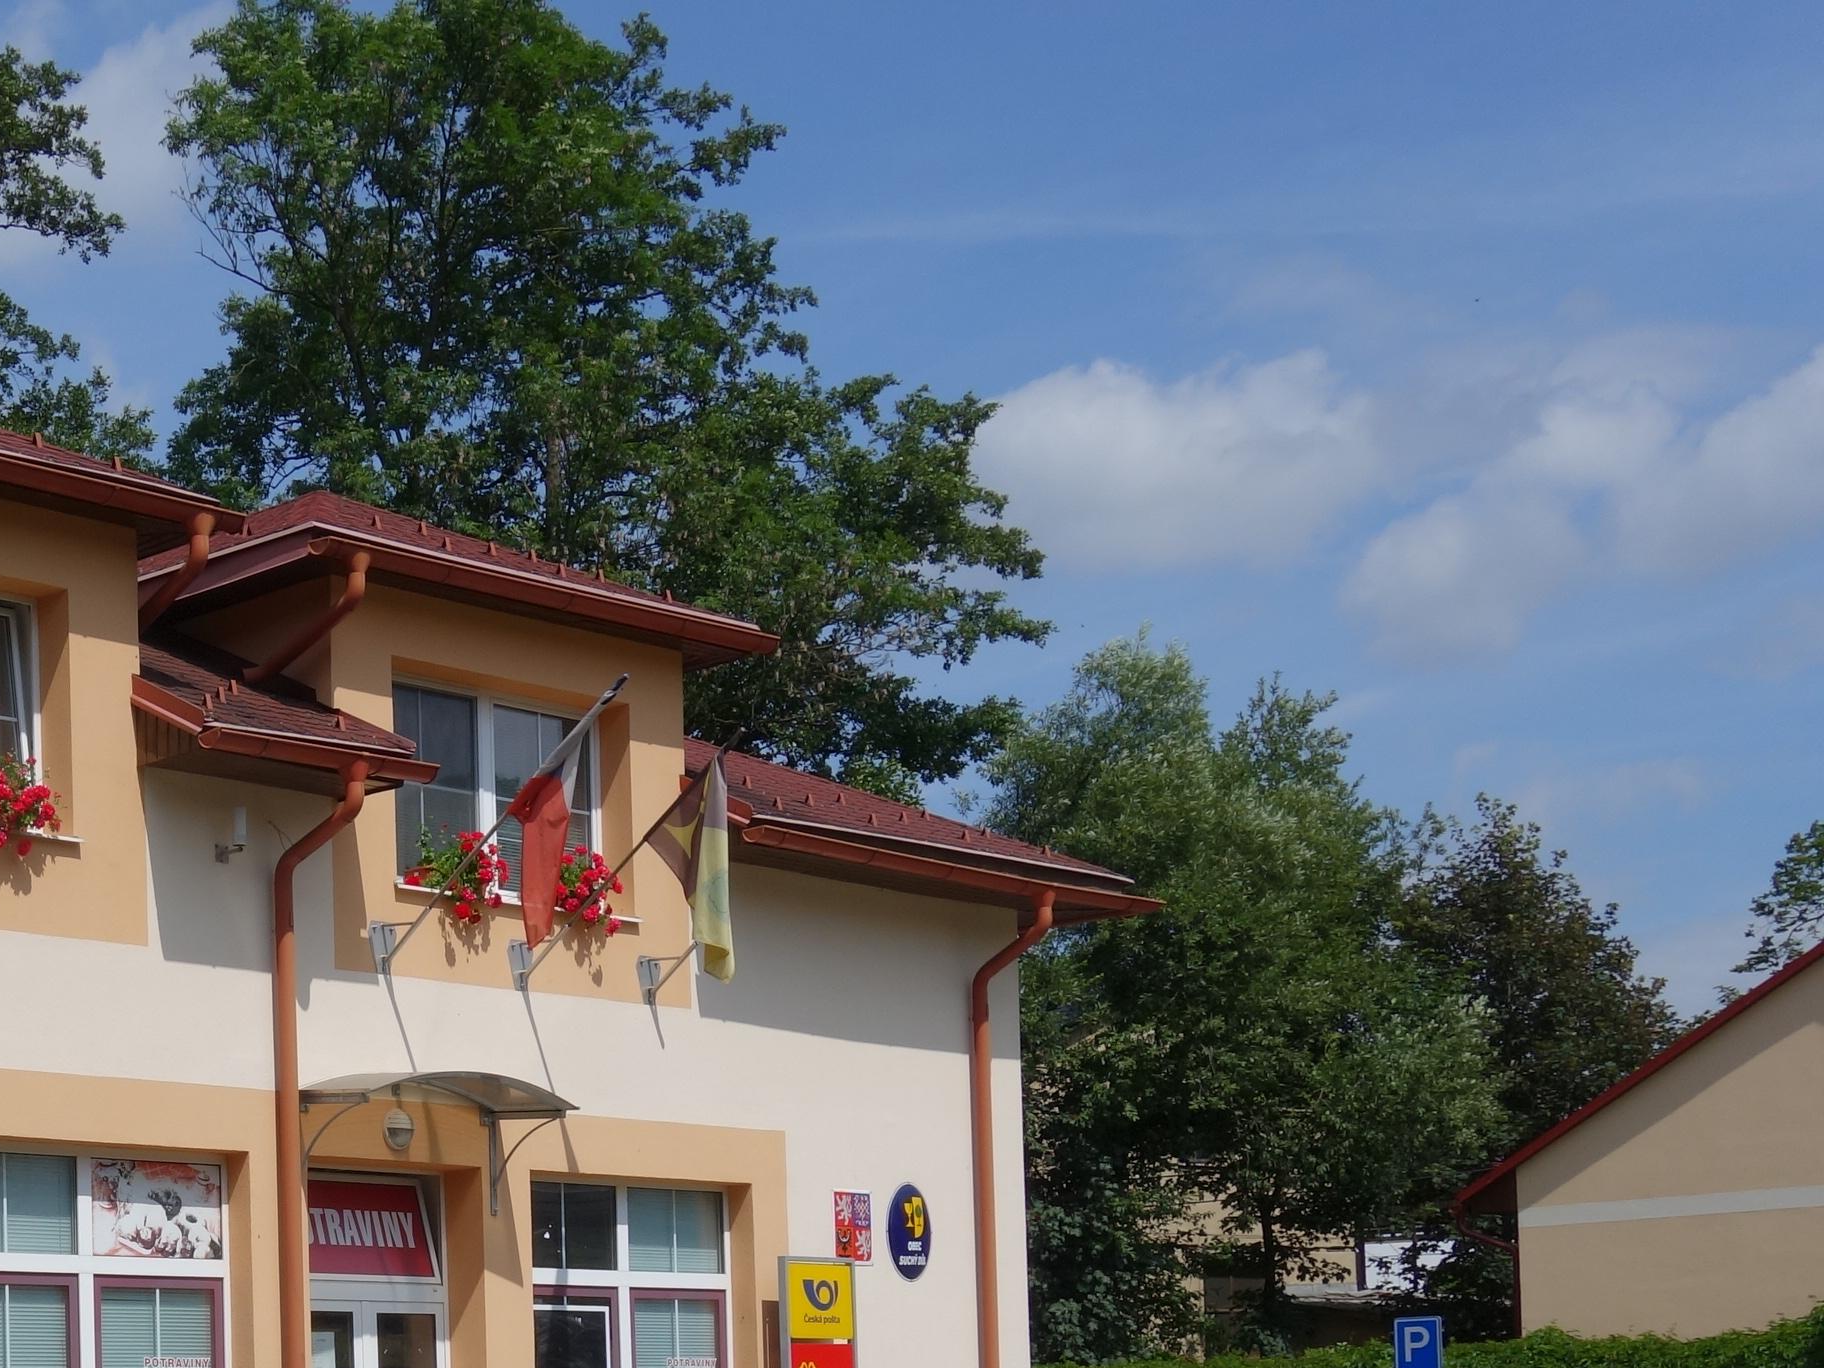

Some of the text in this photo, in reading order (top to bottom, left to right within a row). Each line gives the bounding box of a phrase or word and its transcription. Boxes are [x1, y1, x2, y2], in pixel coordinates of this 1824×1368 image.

[803, 1313, 841, 1325] Česká pošta
[1404, 1326, 1430, 1362] P
[143, 1356, 210, 1368] POTRAVINY
[666, 1357, 717, 1368] POTRAVINY
